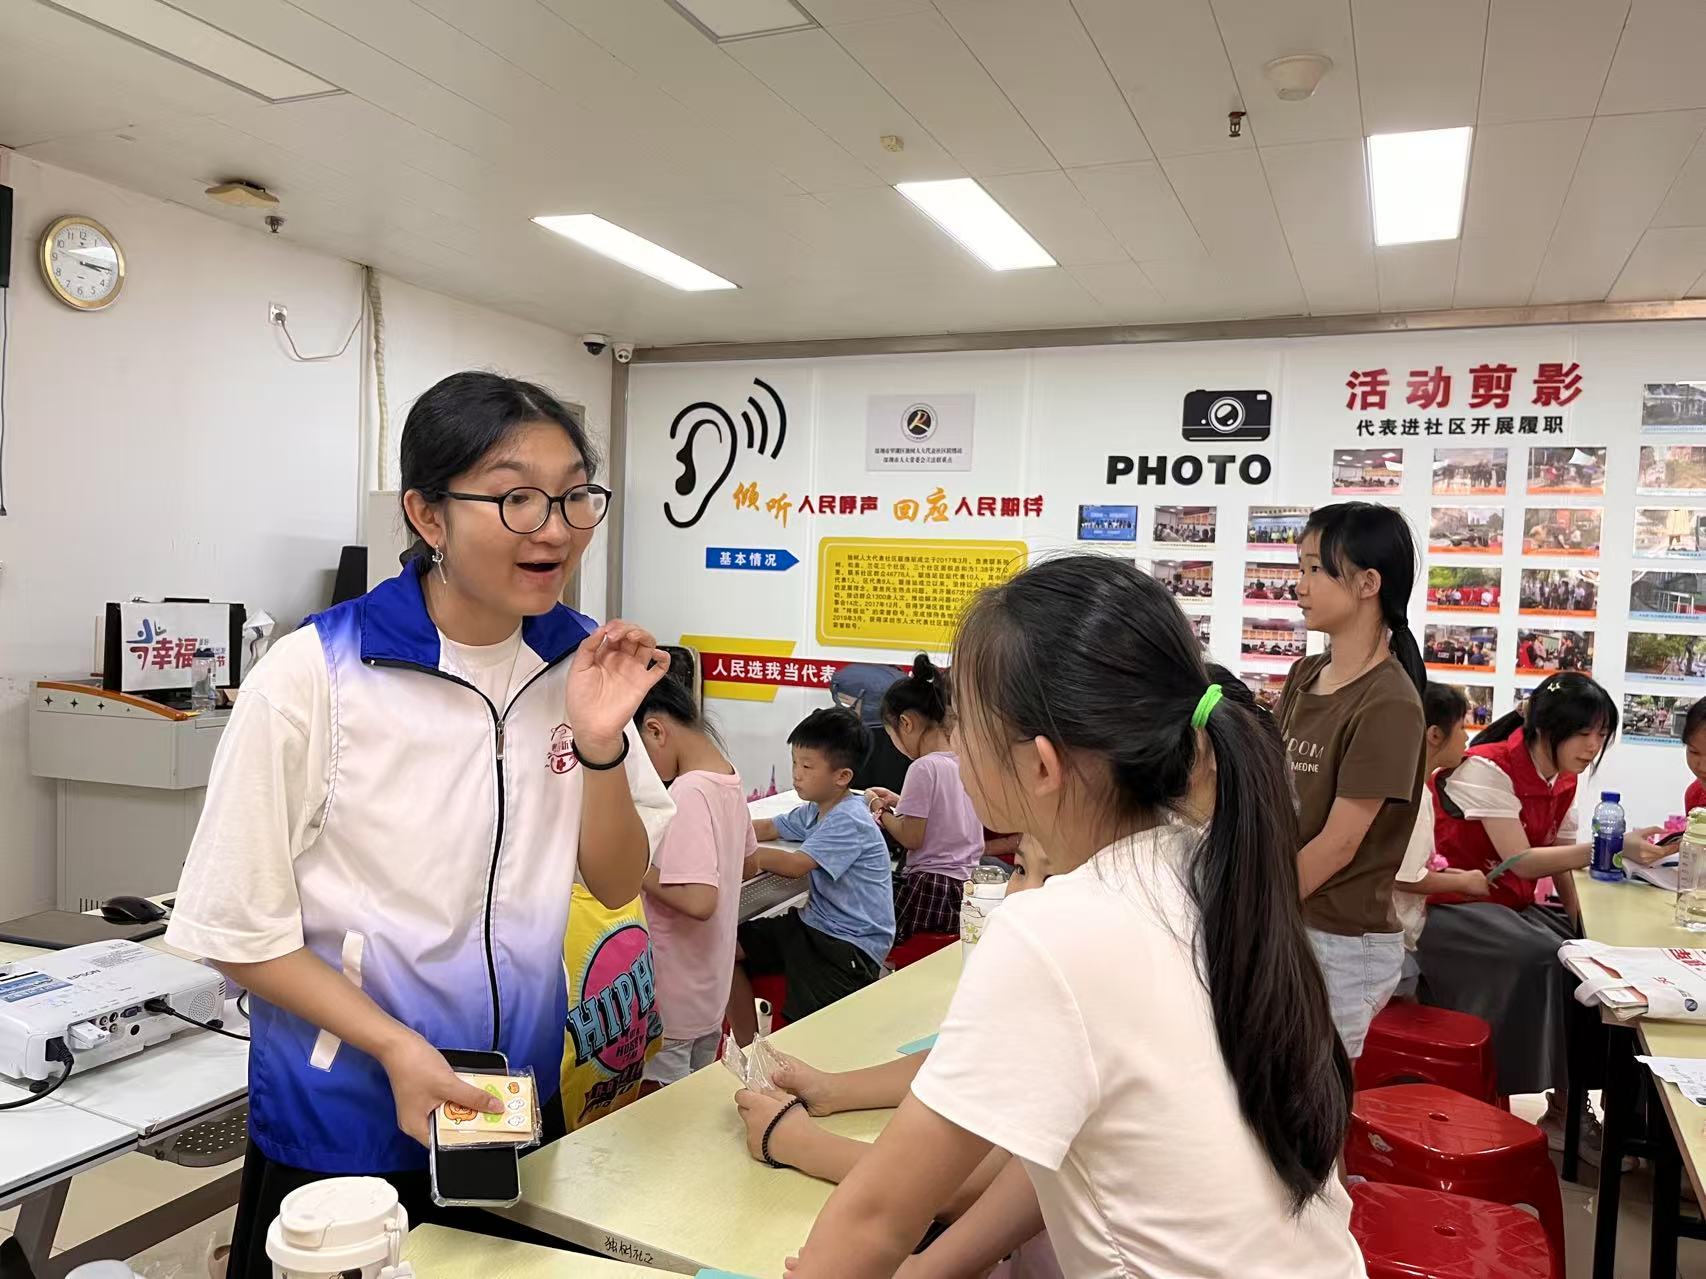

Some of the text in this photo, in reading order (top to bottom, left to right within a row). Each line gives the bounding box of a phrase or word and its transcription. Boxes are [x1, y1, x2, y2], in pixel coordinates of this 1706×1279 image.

[79, 231, 87, 241] 12
[1345, 362, 1583, 411] 活动剪影
[1356, 415, 1564, 437] 代表进社区开展履职
[1106, 453, 1272, 486] PHOTO
[719, 551, 777, 567] 基本情况
[712, 658, 837, 684] 人民选我当代表
[1282, 729, 1325, 759] DOM
